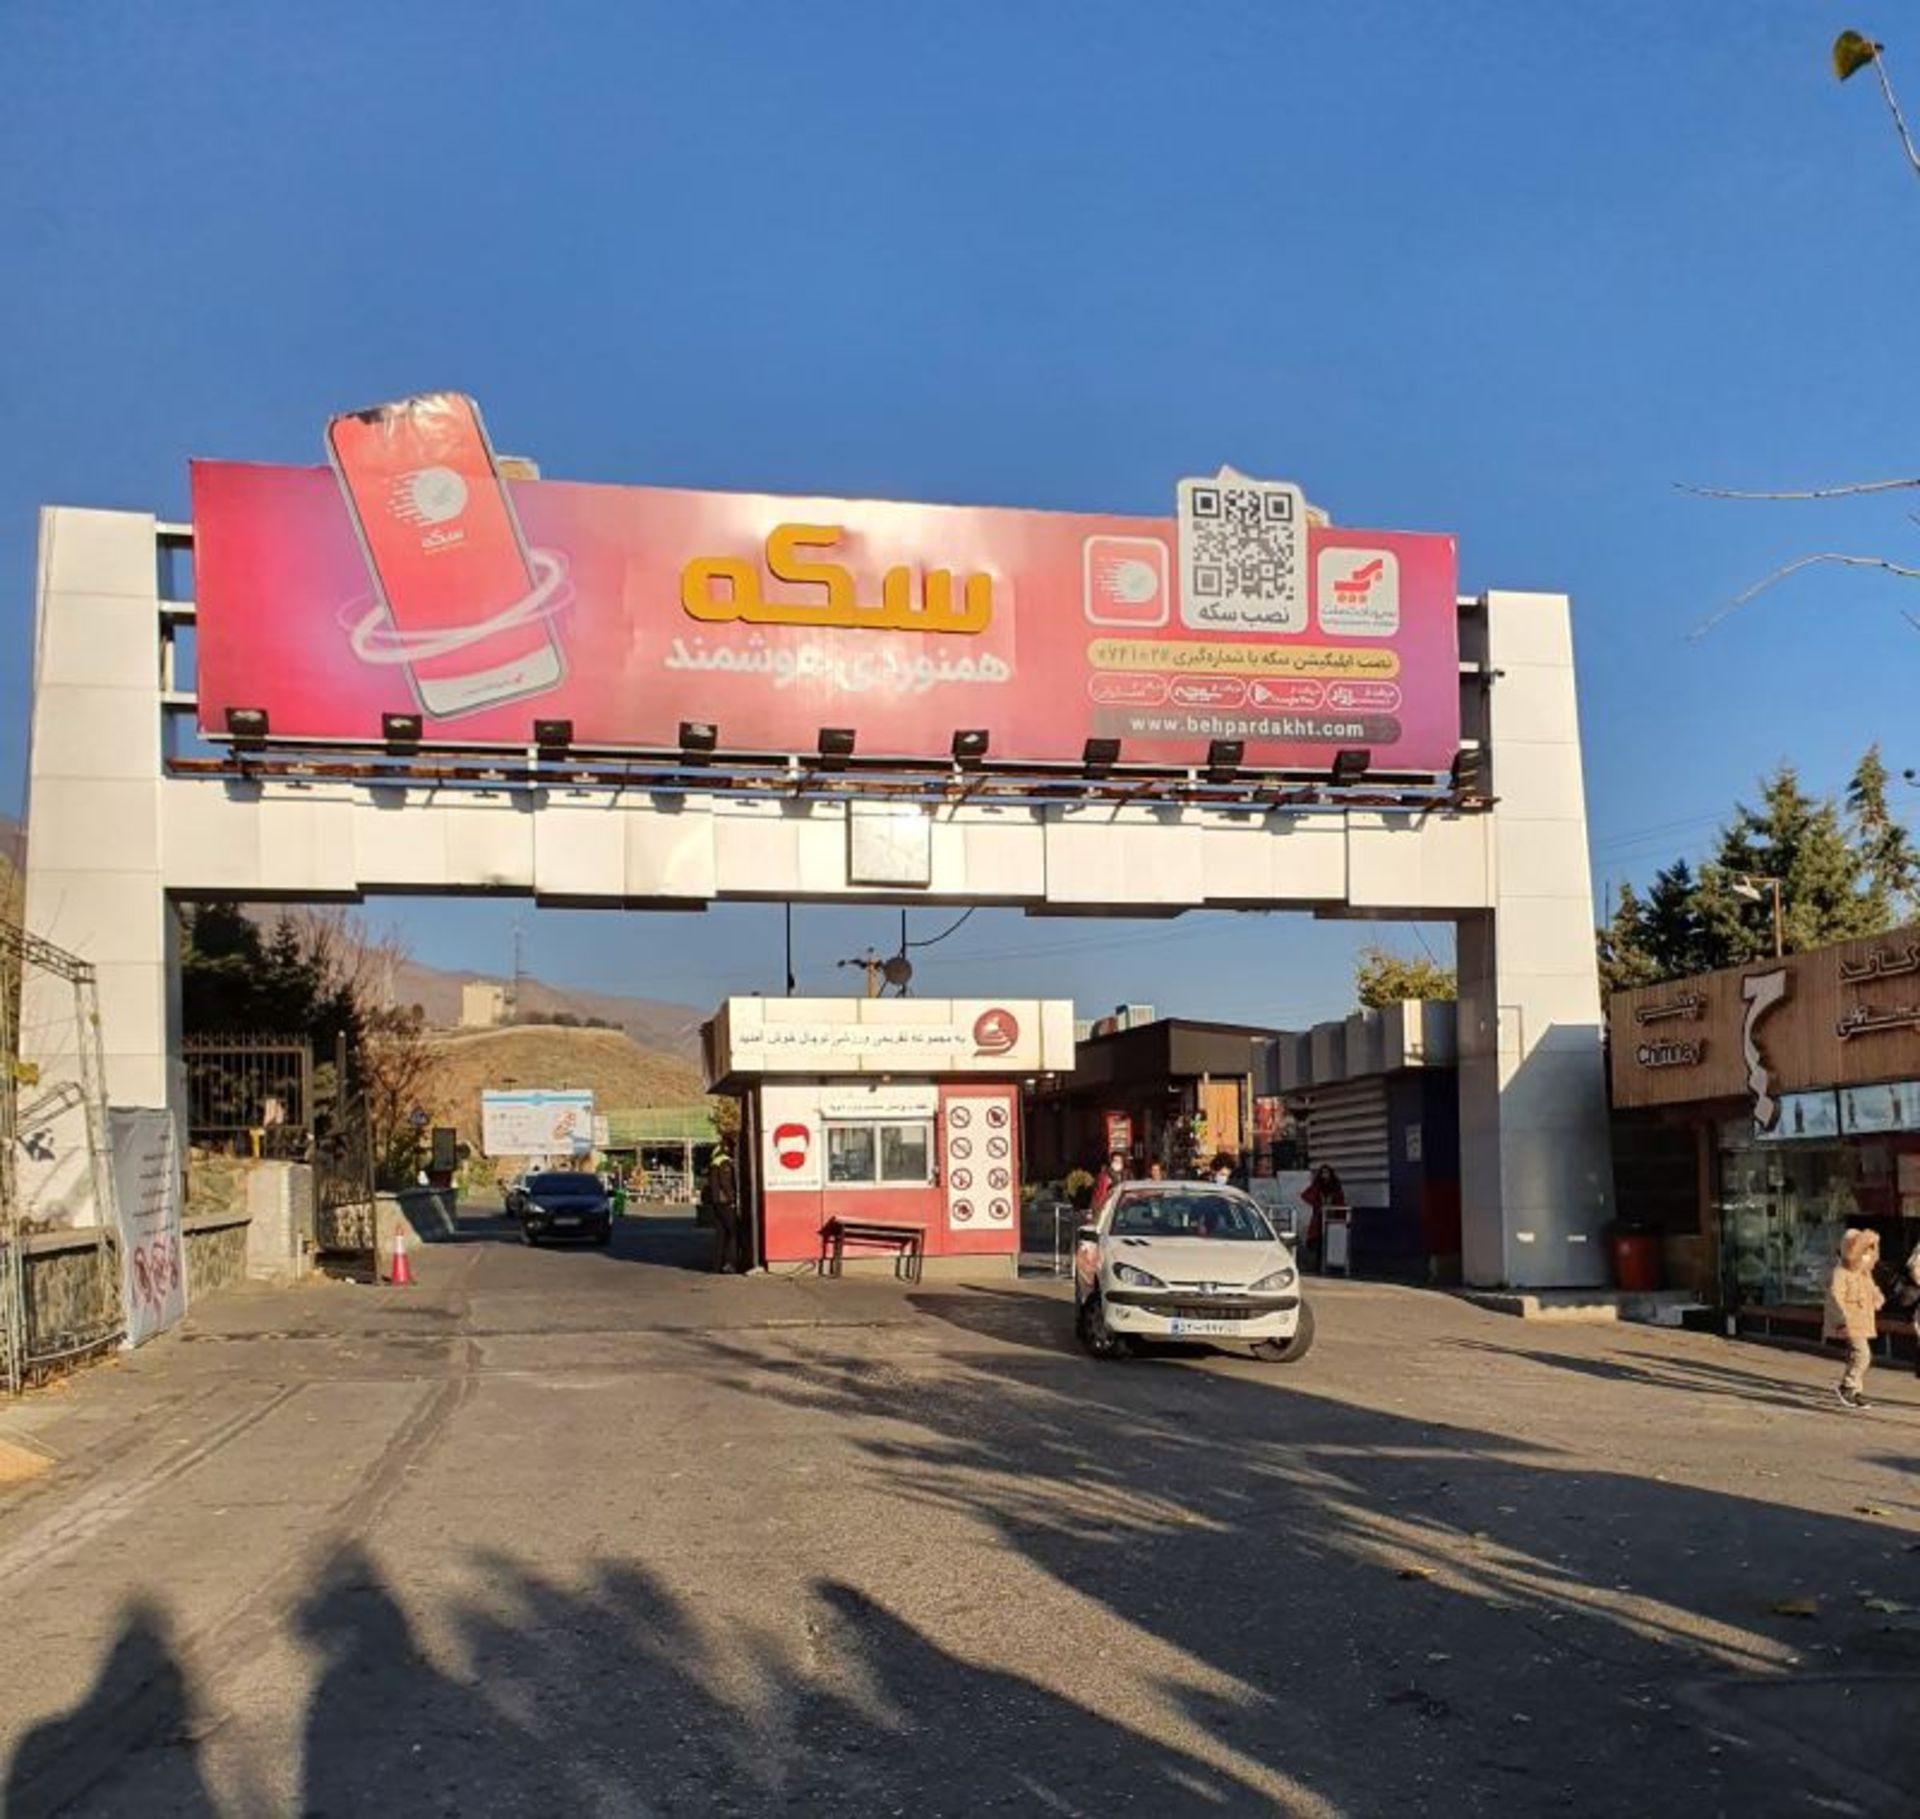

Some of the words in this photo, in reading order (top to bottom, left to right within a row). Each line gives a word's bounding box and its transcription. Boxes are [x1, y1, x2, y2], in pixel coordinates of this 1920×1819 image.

[681, 522, 992, 634] سکه
[1199, 602, 1237, 622] سکه
[1240, 606, 1290, 627] نصب
[1357, 655, 1393, 673] نصب
[1129, 715, 1364, 737] www.behpardakht.com
